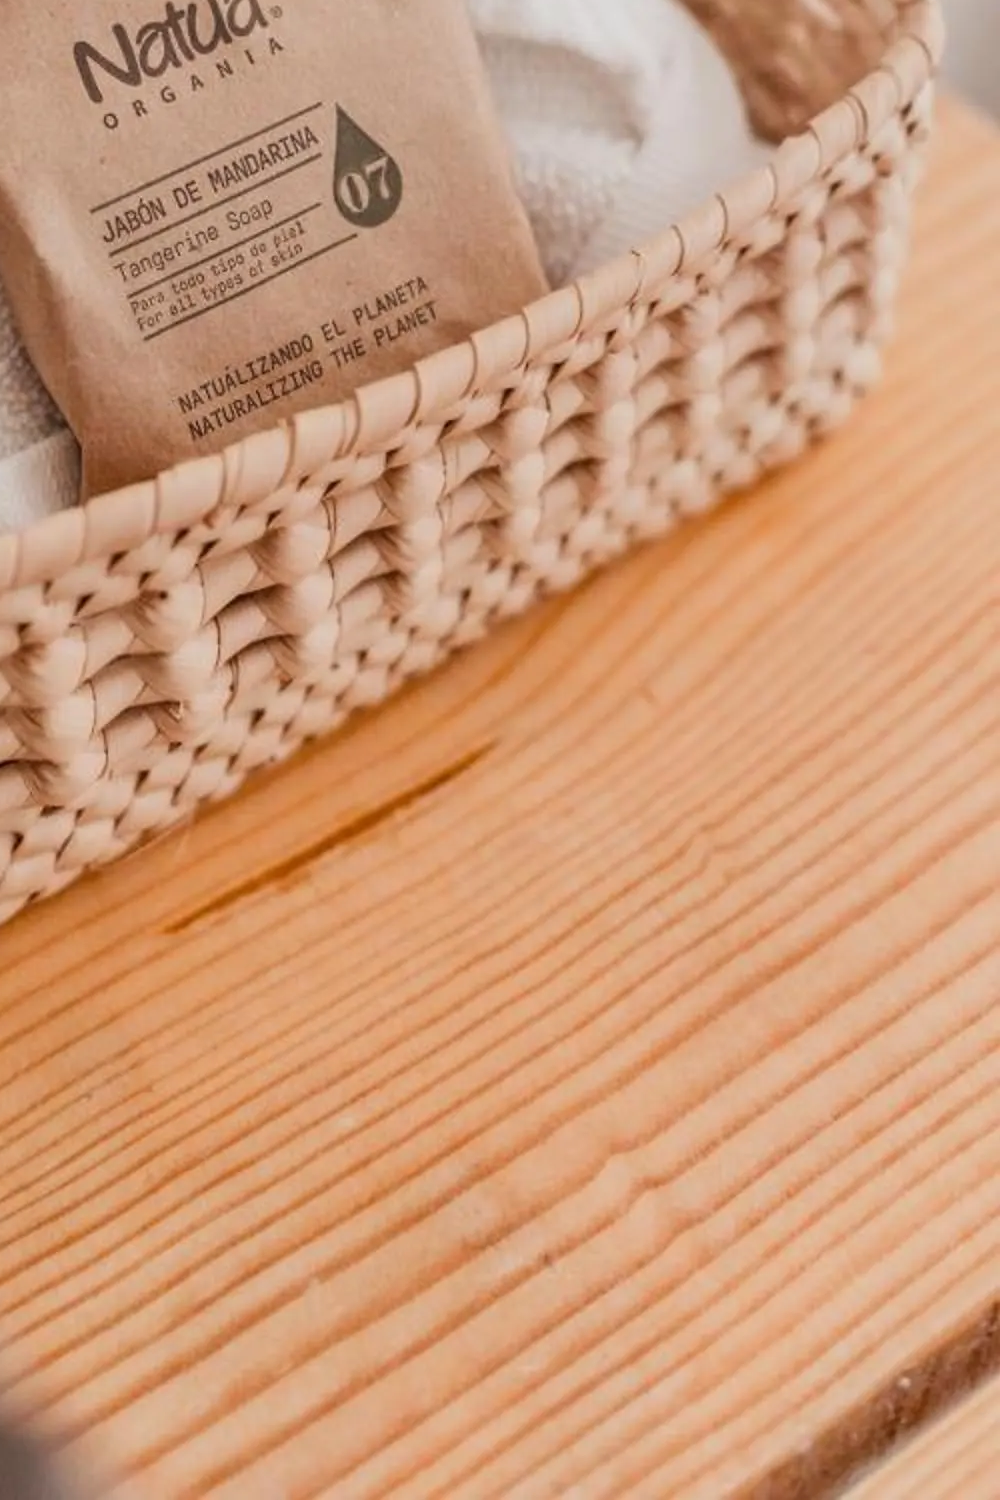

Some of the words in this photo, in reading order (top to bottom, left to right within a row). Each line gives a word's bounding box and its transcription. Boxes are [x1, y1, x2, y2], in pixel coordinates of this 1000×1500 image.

[103, 37, 284, 129] ORGANIA
[102, 197, 167, 244] JABÓN
[172, 179, 203, 209] DE
[207, 125, 319, 193] MANDARINA
[340, 157, 393, 212] 07
[114, 225, 220, 282] Tangerine
[226, 199, 274, 231] Soap
[130, 293, 165, 316] Para
[171, 273, 205, 295] todo
[210, 253, 245, 276] tipo
[250, 242, 267, 258] de
[273, 221, 307, 248] piel
[136, 311, 163, 332] For
[169, 294, 197, 316] all
[201, 273, 244, 301] types
[249, 259, 265, 278] of
[271, 243, 304, 267] skin
[177, 333, 314, 414] NATUÁLIZANDO
[321, 319, 346, 341] EL
[352, 275, 430, 326] PLANETA
[187, 361, 323, 441] NATURALIZING
[331, 339, 367, 368] THE
[373, 302, 438, 347] PLANET
